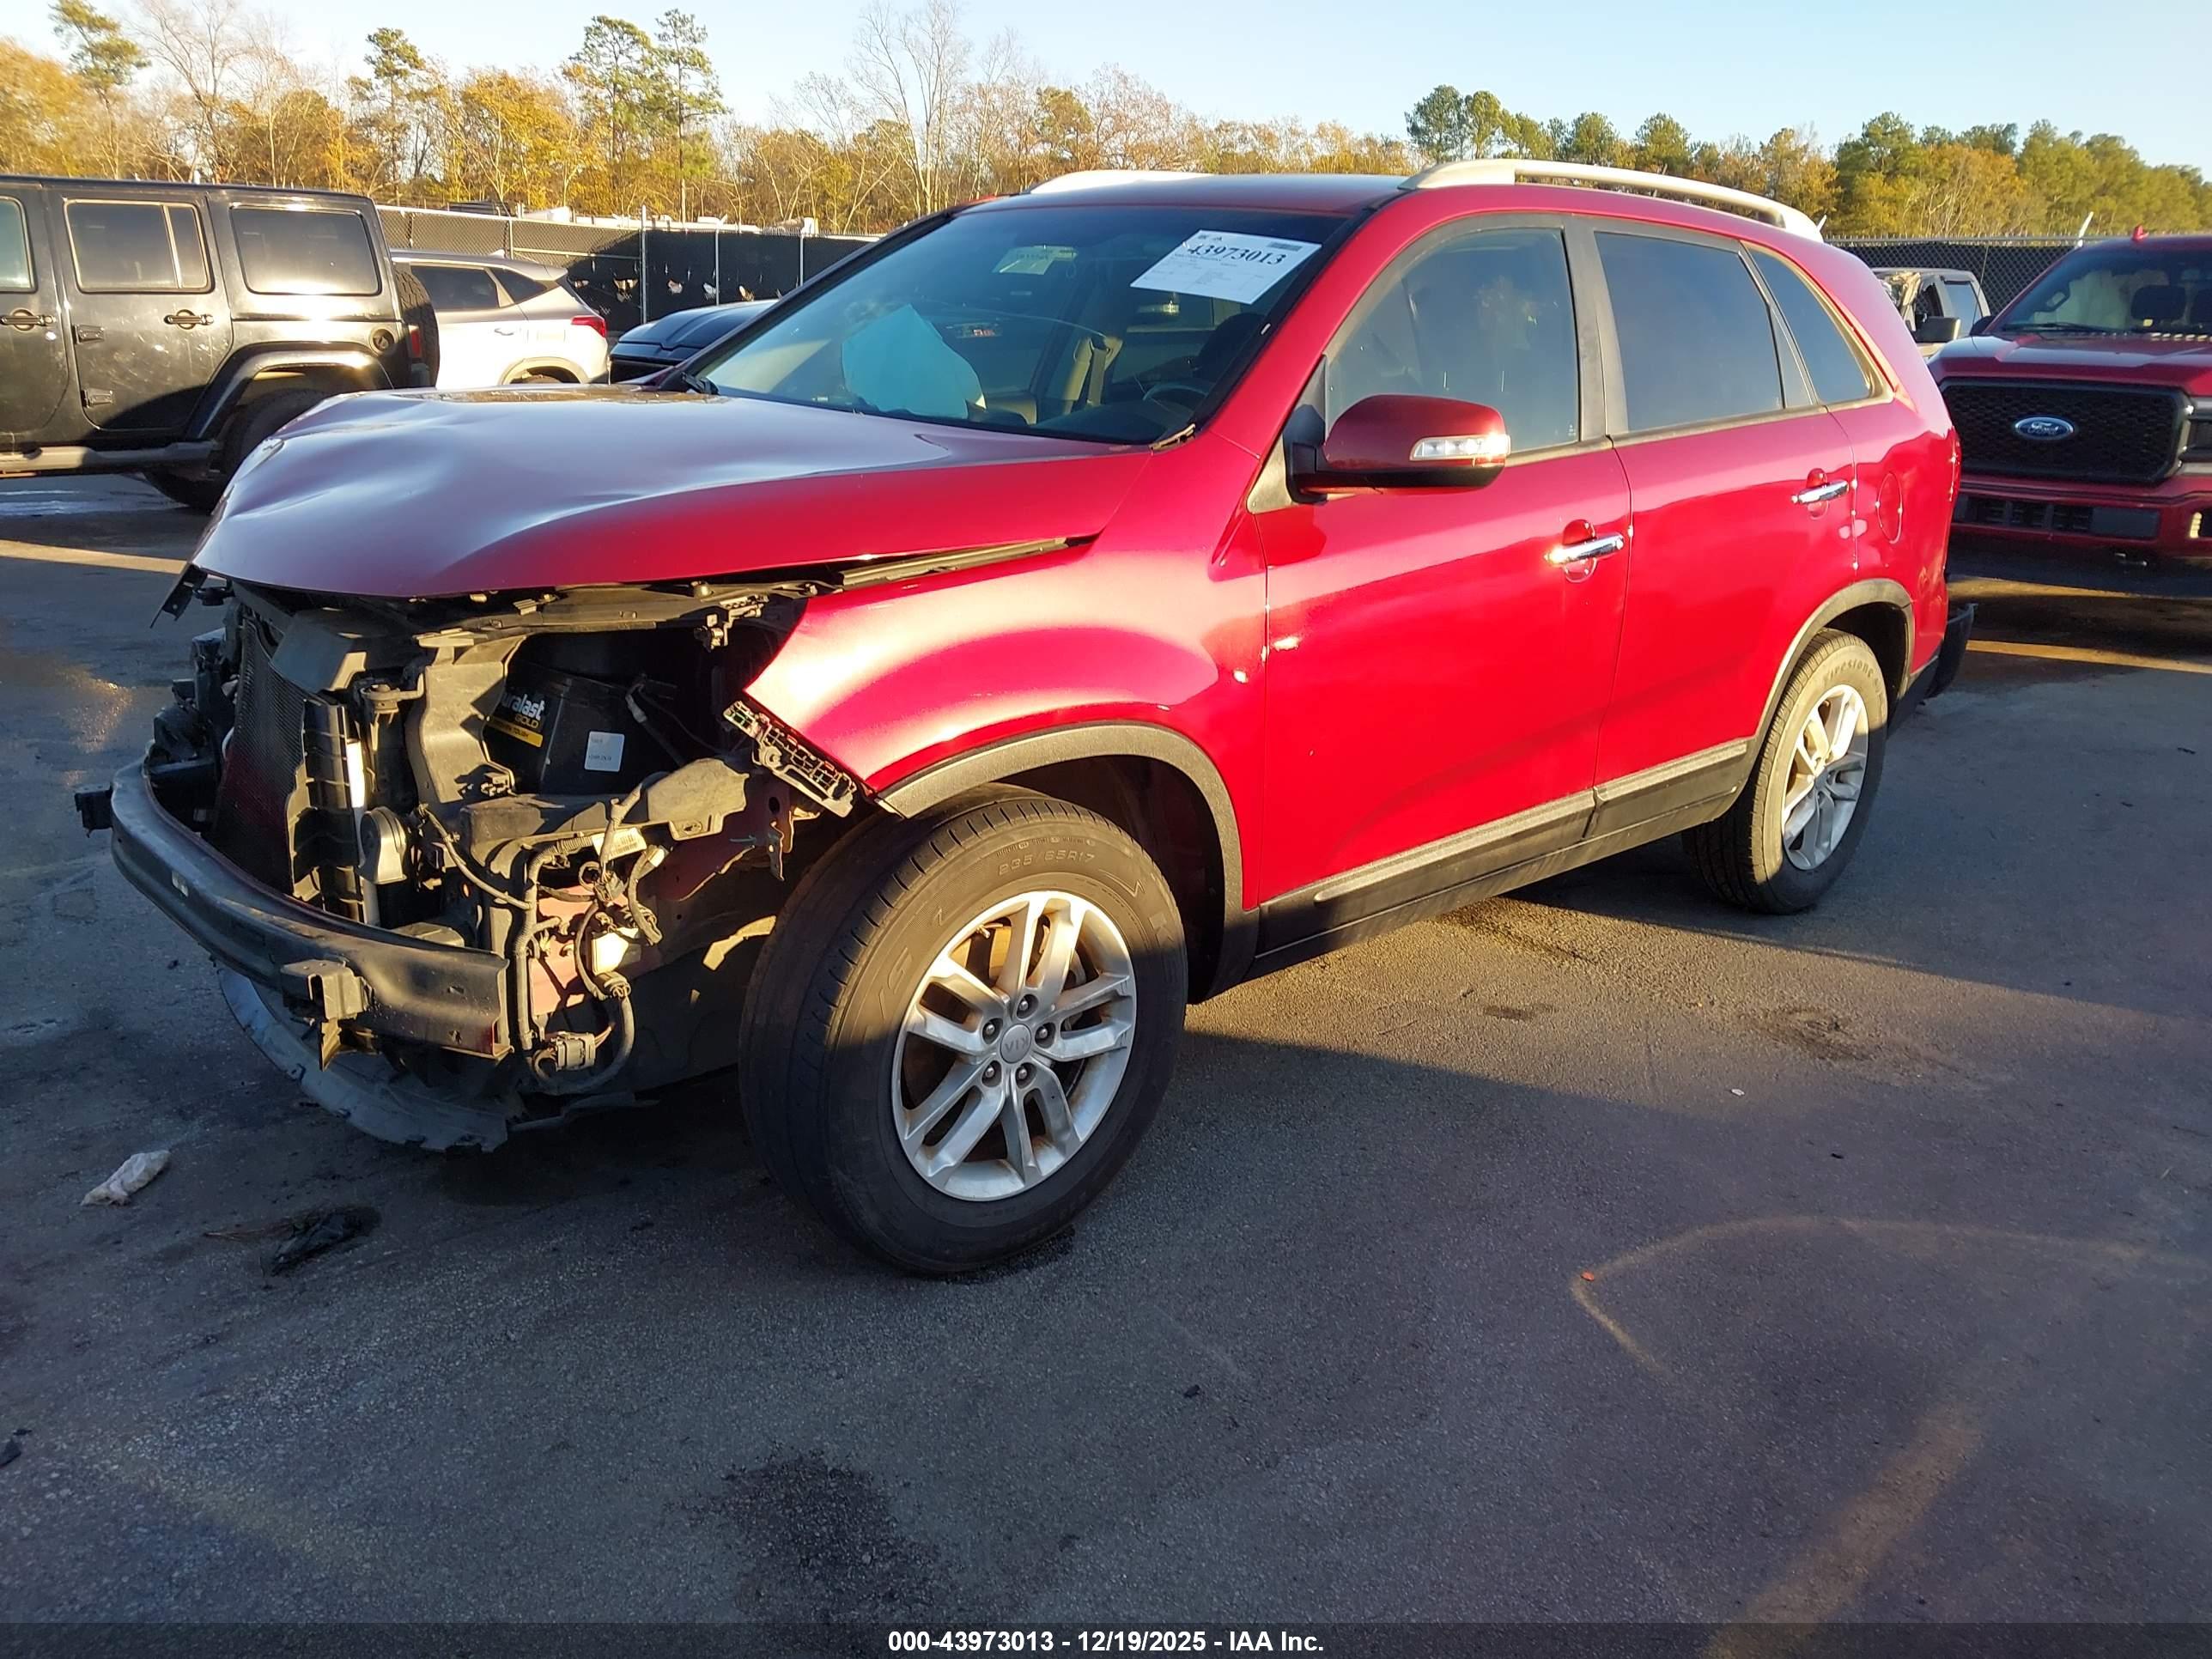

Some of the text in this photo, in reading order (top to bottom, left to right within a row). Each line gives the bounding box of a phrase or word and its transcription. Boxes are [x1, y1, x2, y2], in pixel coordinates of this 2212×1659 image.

[1188, 244, 1286, 265] 43973013
[2027, 421, 2060, 435] Ford
[500, 693, 545, 721] uralast
[515, 713, 540, 729] GOLD
[1005, 1036, 1029, 1053] KIA
